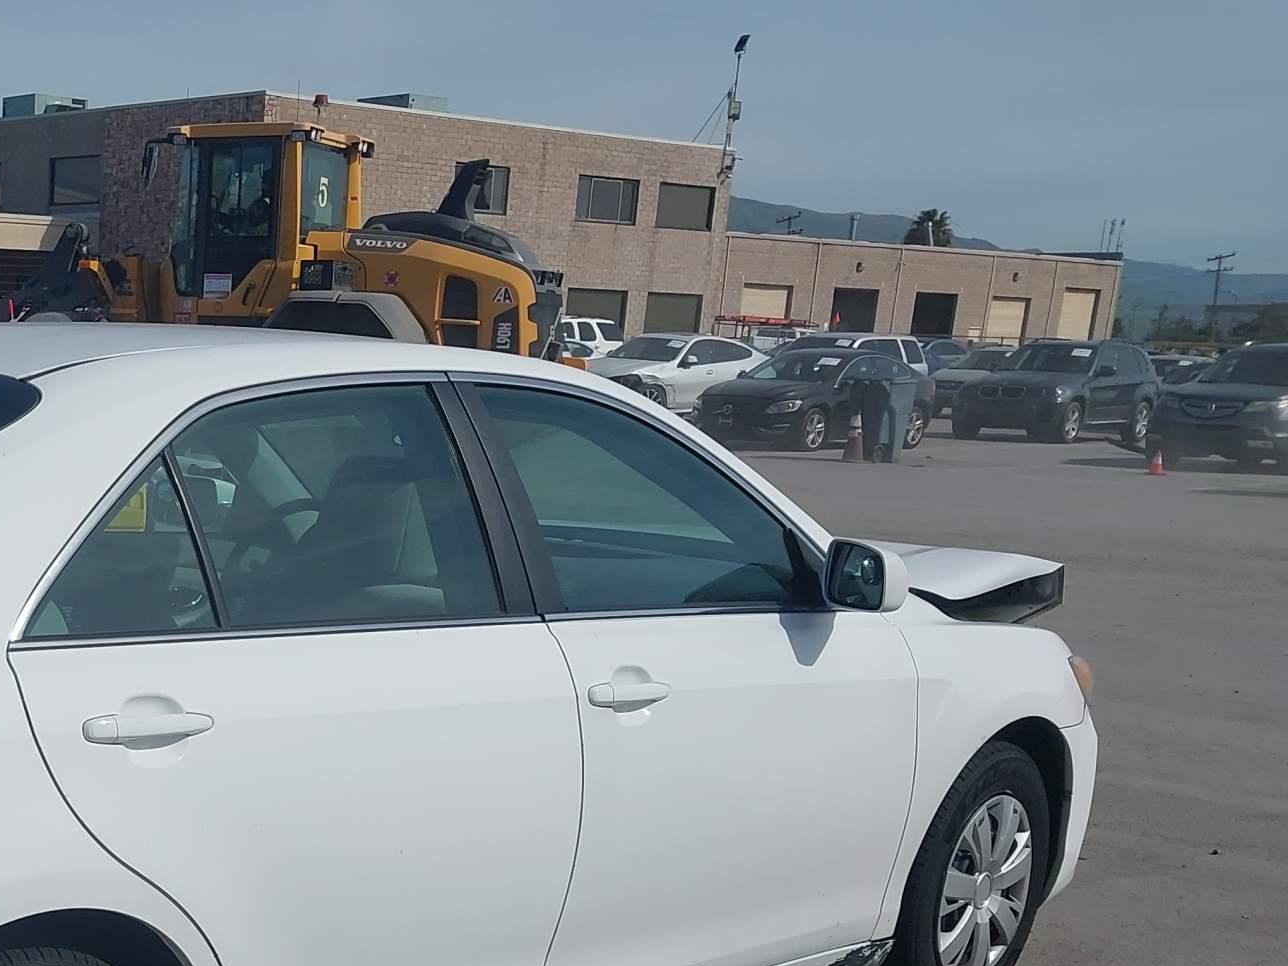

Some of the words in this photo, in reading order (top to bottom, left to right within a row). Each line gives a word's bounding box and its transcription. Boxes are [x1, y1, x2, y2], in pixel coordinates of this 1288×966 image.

[318, 176, 329, 208] 5
[354, 238, 408, 249] VOLVO
[495, 322, 513, 350] L90H
